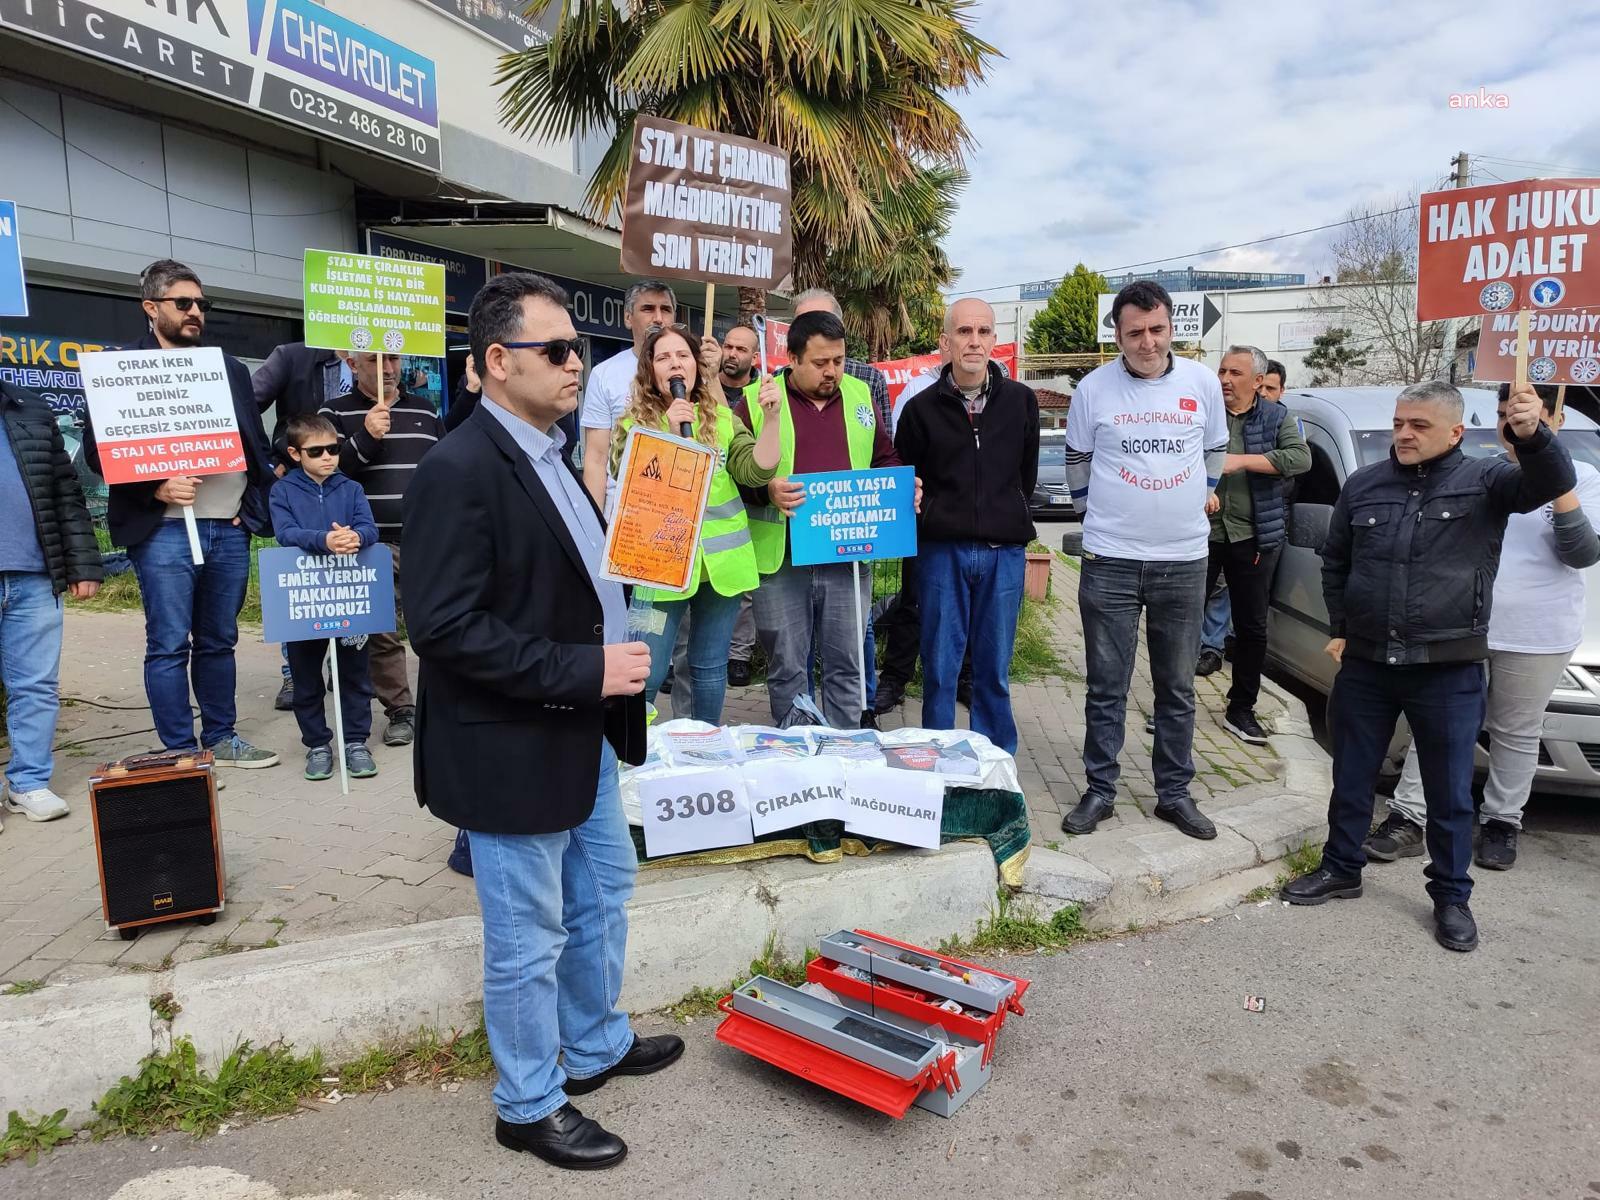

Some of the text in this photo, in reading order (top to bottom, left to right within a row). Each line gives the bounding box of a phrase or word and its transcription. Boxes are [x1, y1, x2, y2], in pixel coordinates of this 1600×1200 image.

[281, 8, 426, 109] CHEVROLET
[289, 88, 427, 155] 0232. 486 28 10
[639, 127, 788, 191] STAJ VE ÇIRAKLIK
[643, 179, 782, 235] MAĞDURİYETİNE
[1428, 189, 1600, 243] HAK HUKU
[327, 256, 424, 276] STAJ VE ÇIRAKLIK
[651, 233, 773, 279] SON VERİLSİN
[1462, 234, 1588, 283] ADALET
[326, 268, 425, 290] İŞLETME VEYA BİR
[310, 283, 371, 299] KURUMDA
[374, 287, 384, 302] İŞ
[387, 291, 440, 305] HAYATINA
[337, 300, 415, 317] BAŞLAMADIR.
[308, 309, 442, 333] ÖĞRENCİLİK OKULDA KALIR
[1184, 324, 1199, 332] 09
[1492, 310, 1600, 333] MAĞDURİY
[1498, 335, 1600, 358] SON VERİL
[118, 356, 194, 372] ÇIRAK İKEN
[92, 371, 224, 388] SİGORTANIZ YAPILDI
[136, 388, 189, 402] DEDİNİZ
[118, 403, 213, 420] YILLAR SONRA
[1113, 412, 1193, 426] STAJ-ÇIRAKLIK
[105, 417, 233, 438] GEÇERSİZ SAYDINIZ
[111, 438, 235, 460] STAJ VE ÇIRAKLIK
[1121, 436, 1185, 454] SİGORTASI
[134, 457, 221, 475] MADURLARI
[856, 477, 896, 495] YAŞTA
[1118, 466, 1192, 491] MAĞDURU
[825, 494, 881, 513] ÇALIŞTIK
[810, 508, 897, 527] SİGORTAMIZI
[830, 523, 878, 541] İSTERİZ
[296, 553, 359, 575] ÇALIŞTIK
[278, 566, 378, 588] EMEK VERDİK
[288, 585, 370, 603] HAKKIMIZI
[289, 600, 371, 620] İSTİYORUZ!
[655, 789, 737, 823] 3308
[755, 785, 845, 818] ÇIRAKLIK
[850, 795, 937, 821] MAĞDURLARI
